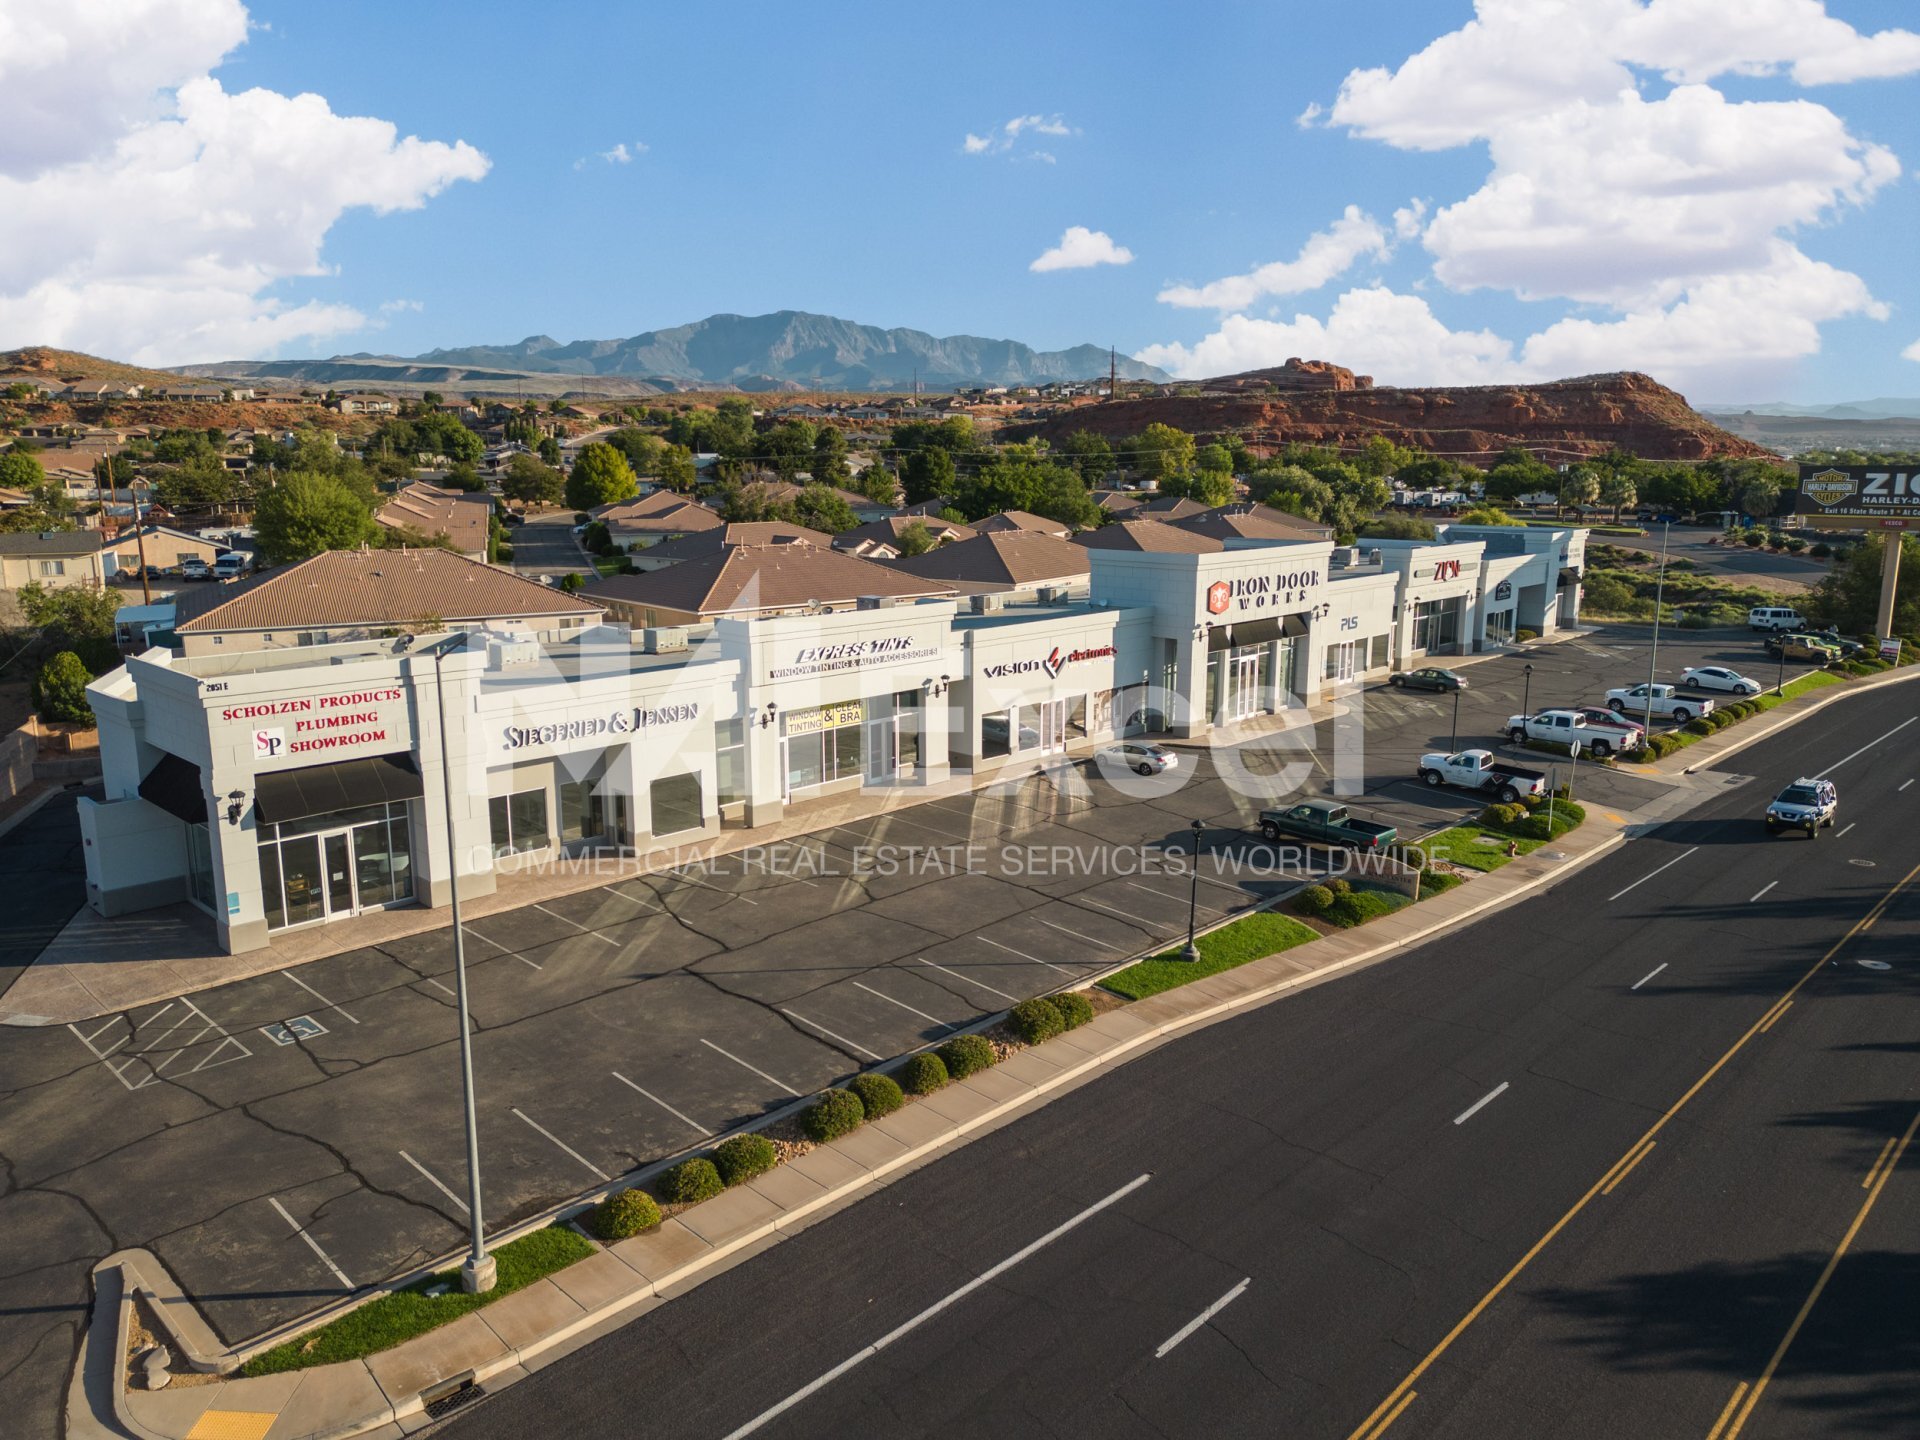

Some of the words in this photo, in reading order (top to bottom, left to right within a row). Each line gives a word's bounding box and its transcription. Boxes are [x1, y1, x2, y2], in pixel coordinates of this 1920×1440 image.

[1862, 496, 1920, 504] HARLEY-D
[1229, 575, 1270, 597] IRON
[1276, 570, 1319, 591] DOOR
[1238, 589, 1307, 610] WORKS
[1340, 616, 1358, 631] PLS
[796, 641, 870, 664] EXPRESS
[870, 636, 915, 654] TINTS
[1068, 645, 1117, 663] electronics
[770, 664, 812, 679] WINDOW
[812, 660, 849, 674] TINTING
[858, 654, 882, 667] AUTO
[883, 648, 938, 663] ACCESSORIES
[222, 699, 311, 721] SCHOLZEN
[319, 688, 401, 709] PRODUCTS
[835, 700, 864, 713] CLEAR
[296, 711, 379, 732] PLUMBING
[788, 707, 822, 722] WINDOW
[823, 708, 833, 722] &
[840, 711, 861, 723] BRA
[504, 718, 607, 750] SIEGFRIED
[608, 710, 631, 733] &
[630, 703, 699, 733] JENSEN
[789, 719, 822, 733] TINTING
[290, 730, 386, 753] SHOWROOM
